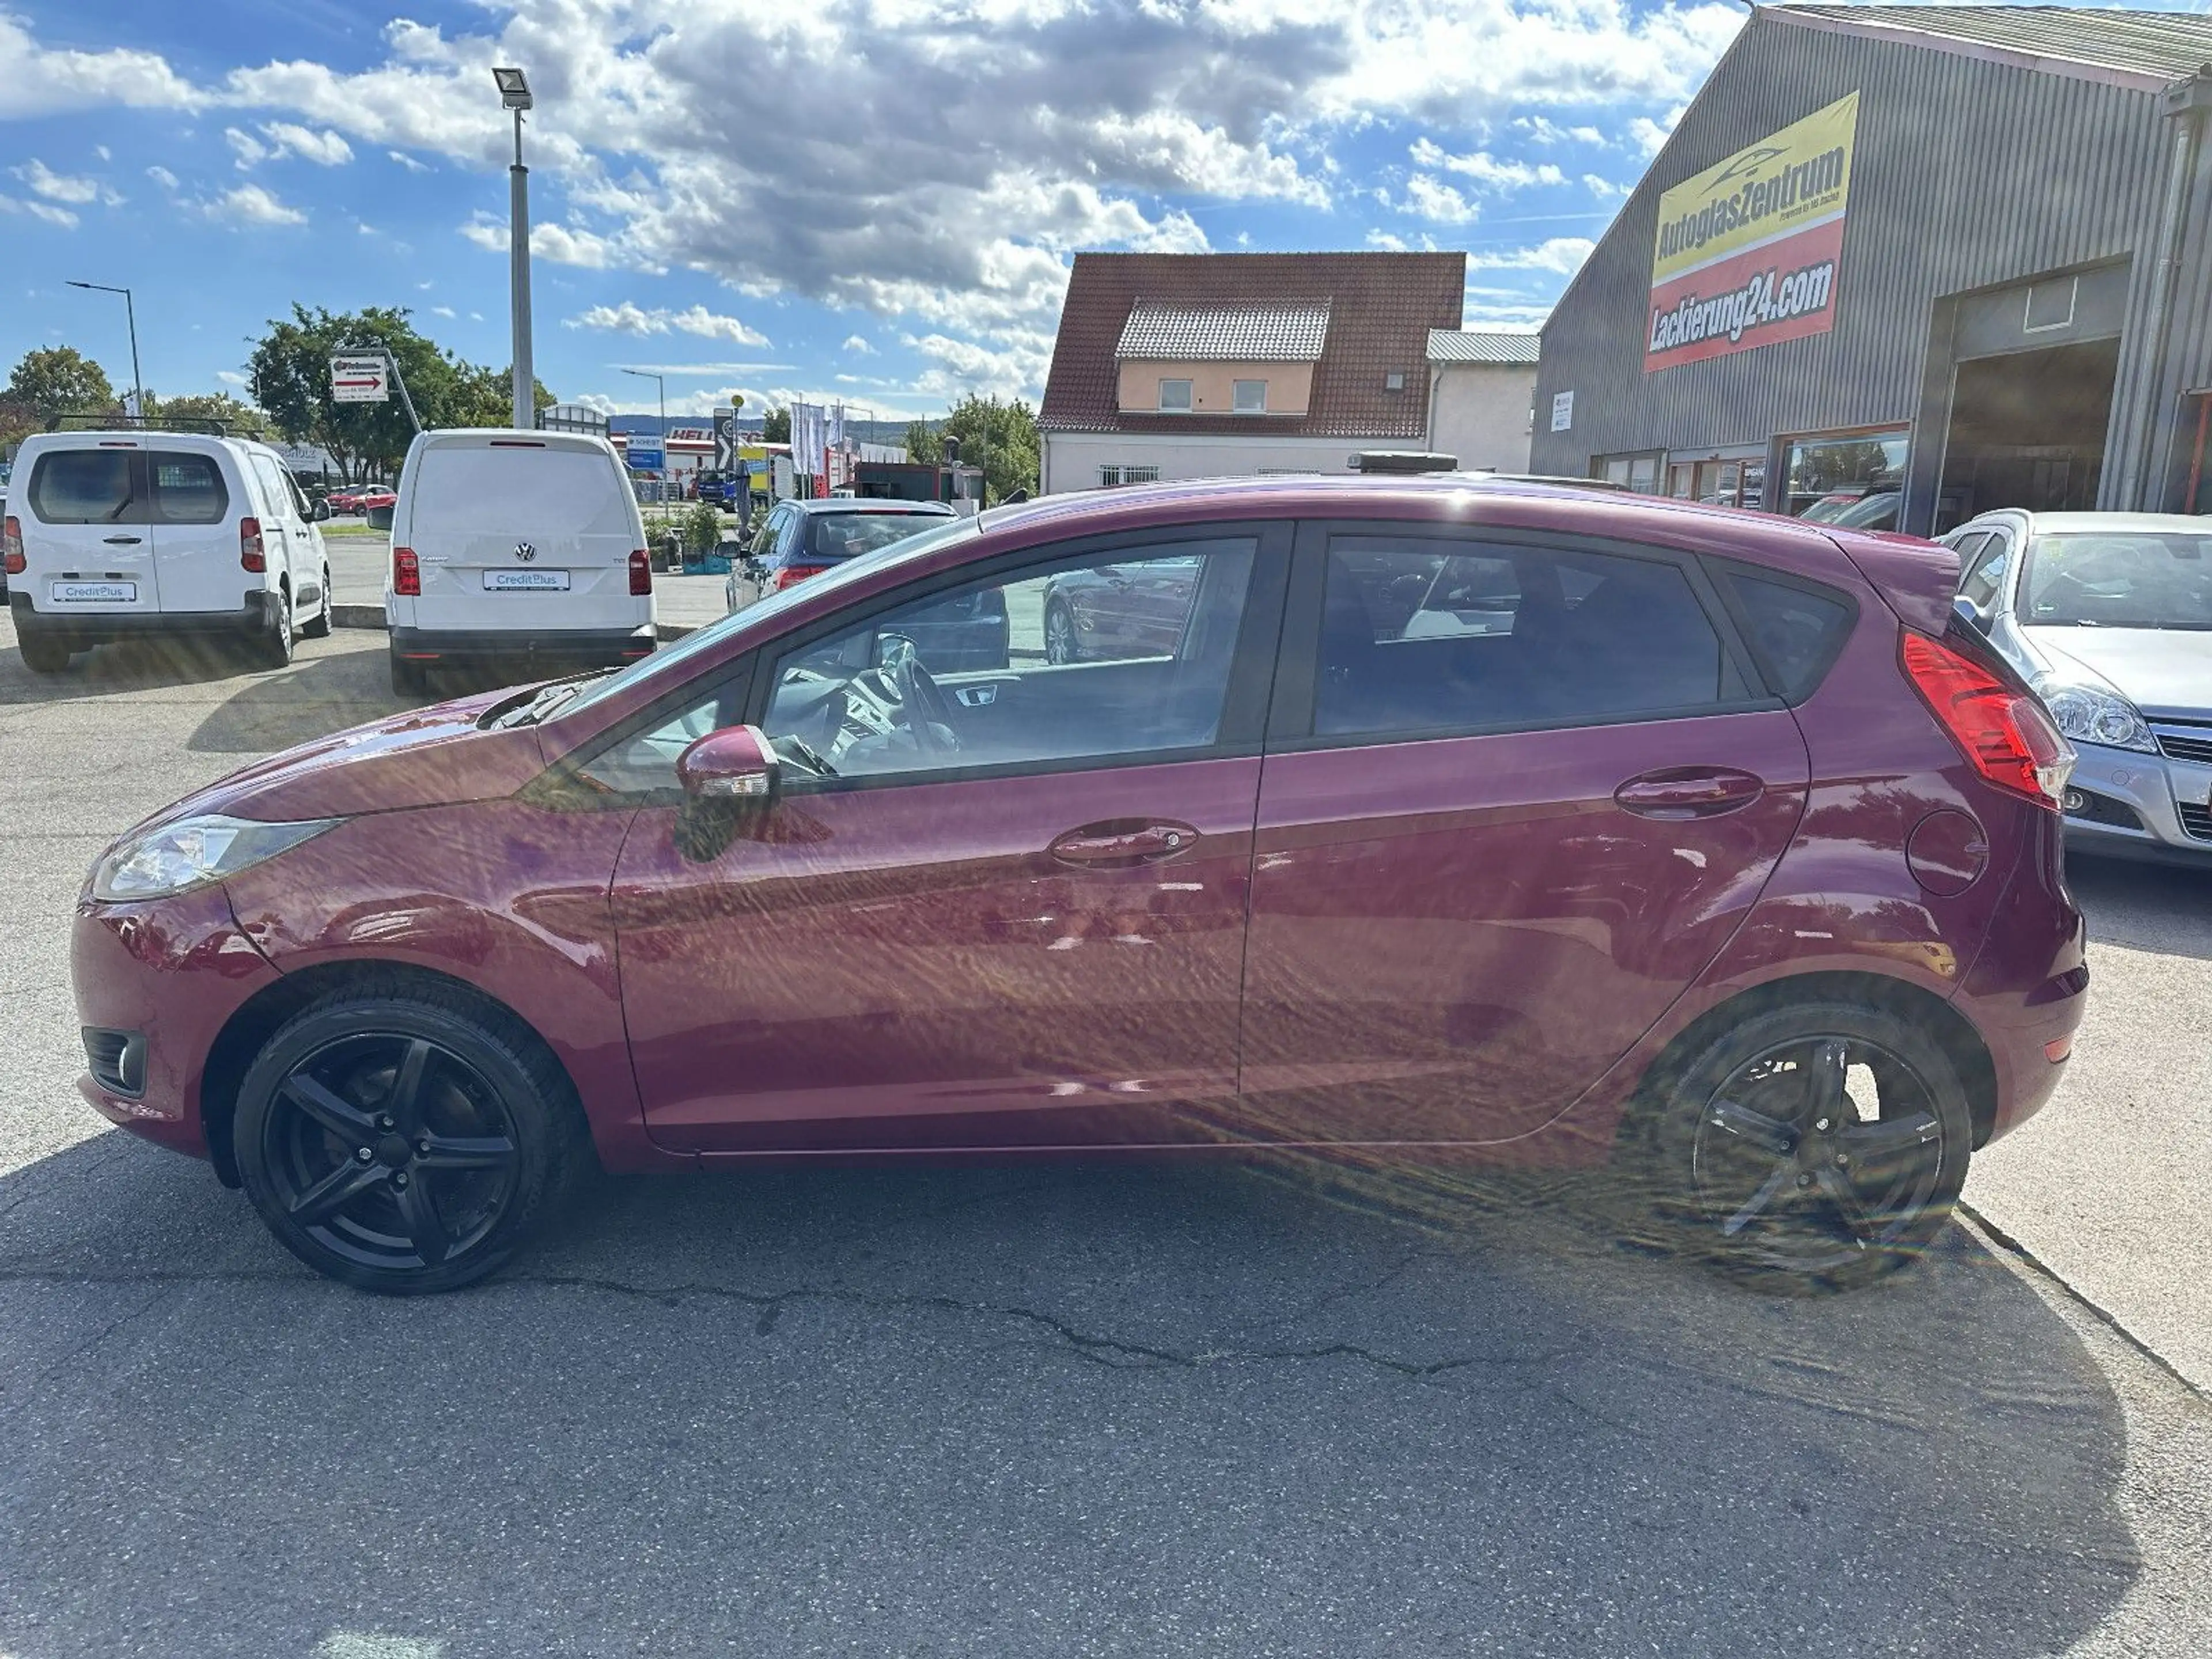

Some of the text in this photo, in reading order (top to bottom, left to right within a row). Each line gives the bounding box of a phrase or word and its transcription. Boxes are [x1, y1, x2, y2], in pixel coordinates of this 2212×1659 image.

[1658, 146, 1844, 261] AutoglasZentrum
[1649, 263, 1834, 351] Lackierung24.com
[66, 586, 123, 596] CreditPlus
[498, 575, 556, 584] CreditPlus
